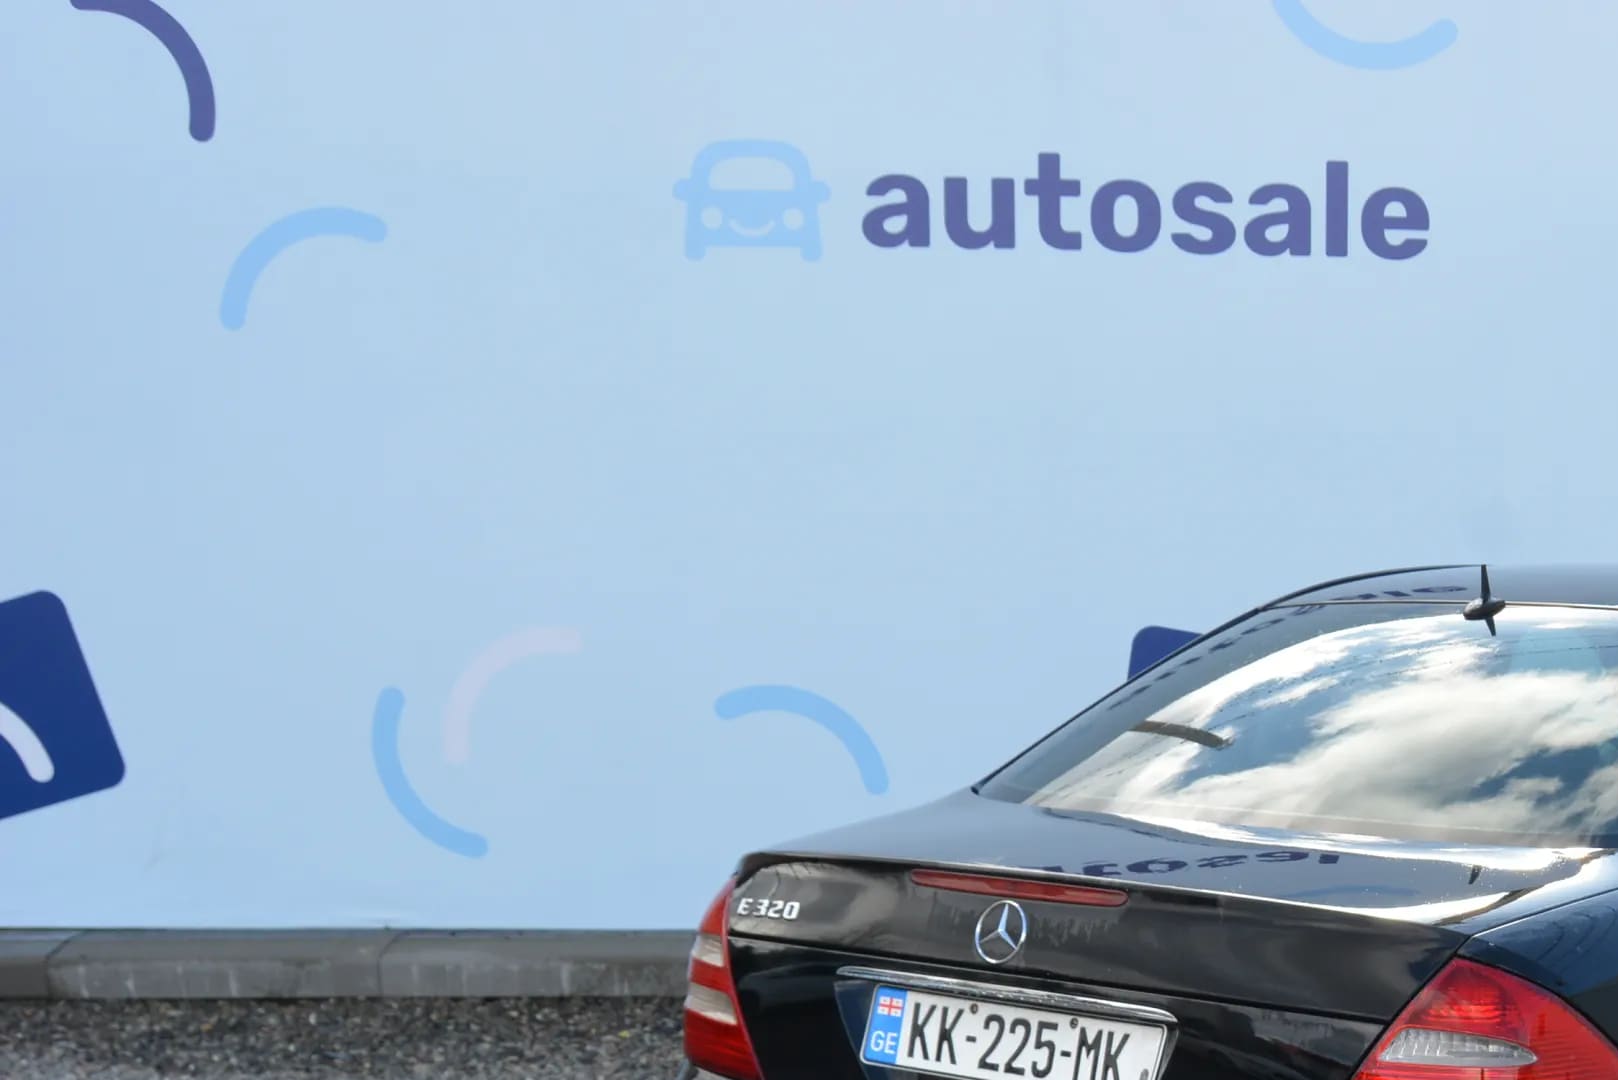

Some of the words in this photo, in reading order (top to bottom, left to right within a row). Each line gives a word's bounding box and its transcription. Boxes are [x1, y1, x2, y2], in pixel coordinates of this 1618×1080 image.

[862, 152, 1430, 260] autosale
[736, 897, 753, 916] E
[753, 899, 801, 920] 320
[869, 1030, 898, 1055] GE
